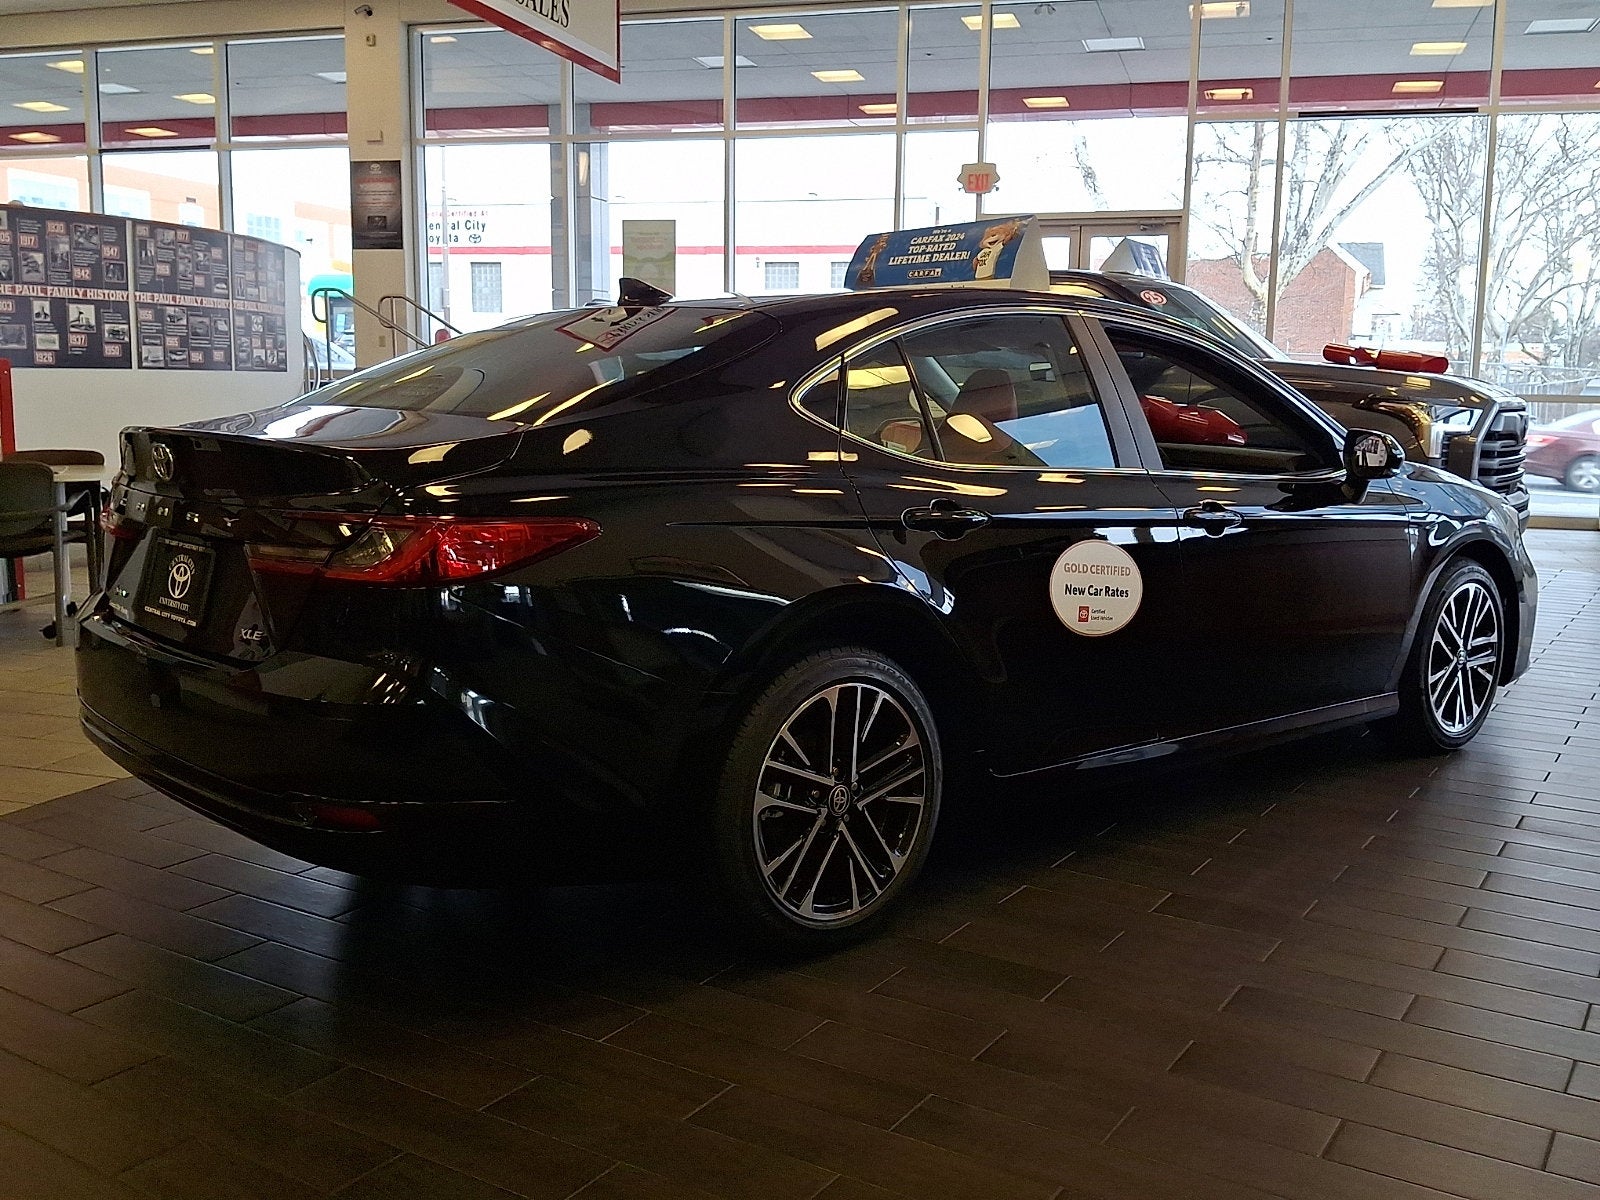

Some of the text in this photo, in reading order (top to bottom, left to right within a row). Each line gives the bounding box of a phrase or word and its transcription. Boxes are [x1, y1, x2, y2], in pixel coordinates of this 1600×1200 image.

[968, 173, 990, 191] EXIT
[428, 219, 487, 233] enal City
[0, 234, 10, 244] 05
[19, 235, 36, 246] 1917
[428, 233, 459, 245] oyta
[910, 232, 966, 245] CARFAX 2024
[908, 242, 957, 254] TOP-RATED
[888, 251, 971, 266] LIFETIME DEALER!
[0, 285, 128, 301] HE PAUL FAMILY HISTORY
[135, 292, 229, 308] THE PAUL FAMILY HISTORY
[69, 335, 86, 345] 1937
[35, 352, 53, 363] 1926
[1063, 562, 1131, 577] GOLD CERTIFIED
[1064, 583, 1129, 598] New Car Rates
[144, 605, 162, 616] CENTRAL
[161, 611, 171, 619] CITY
[170, 614, 186, 624] TOYOTA
[241, 628, 264, 641] XLE
